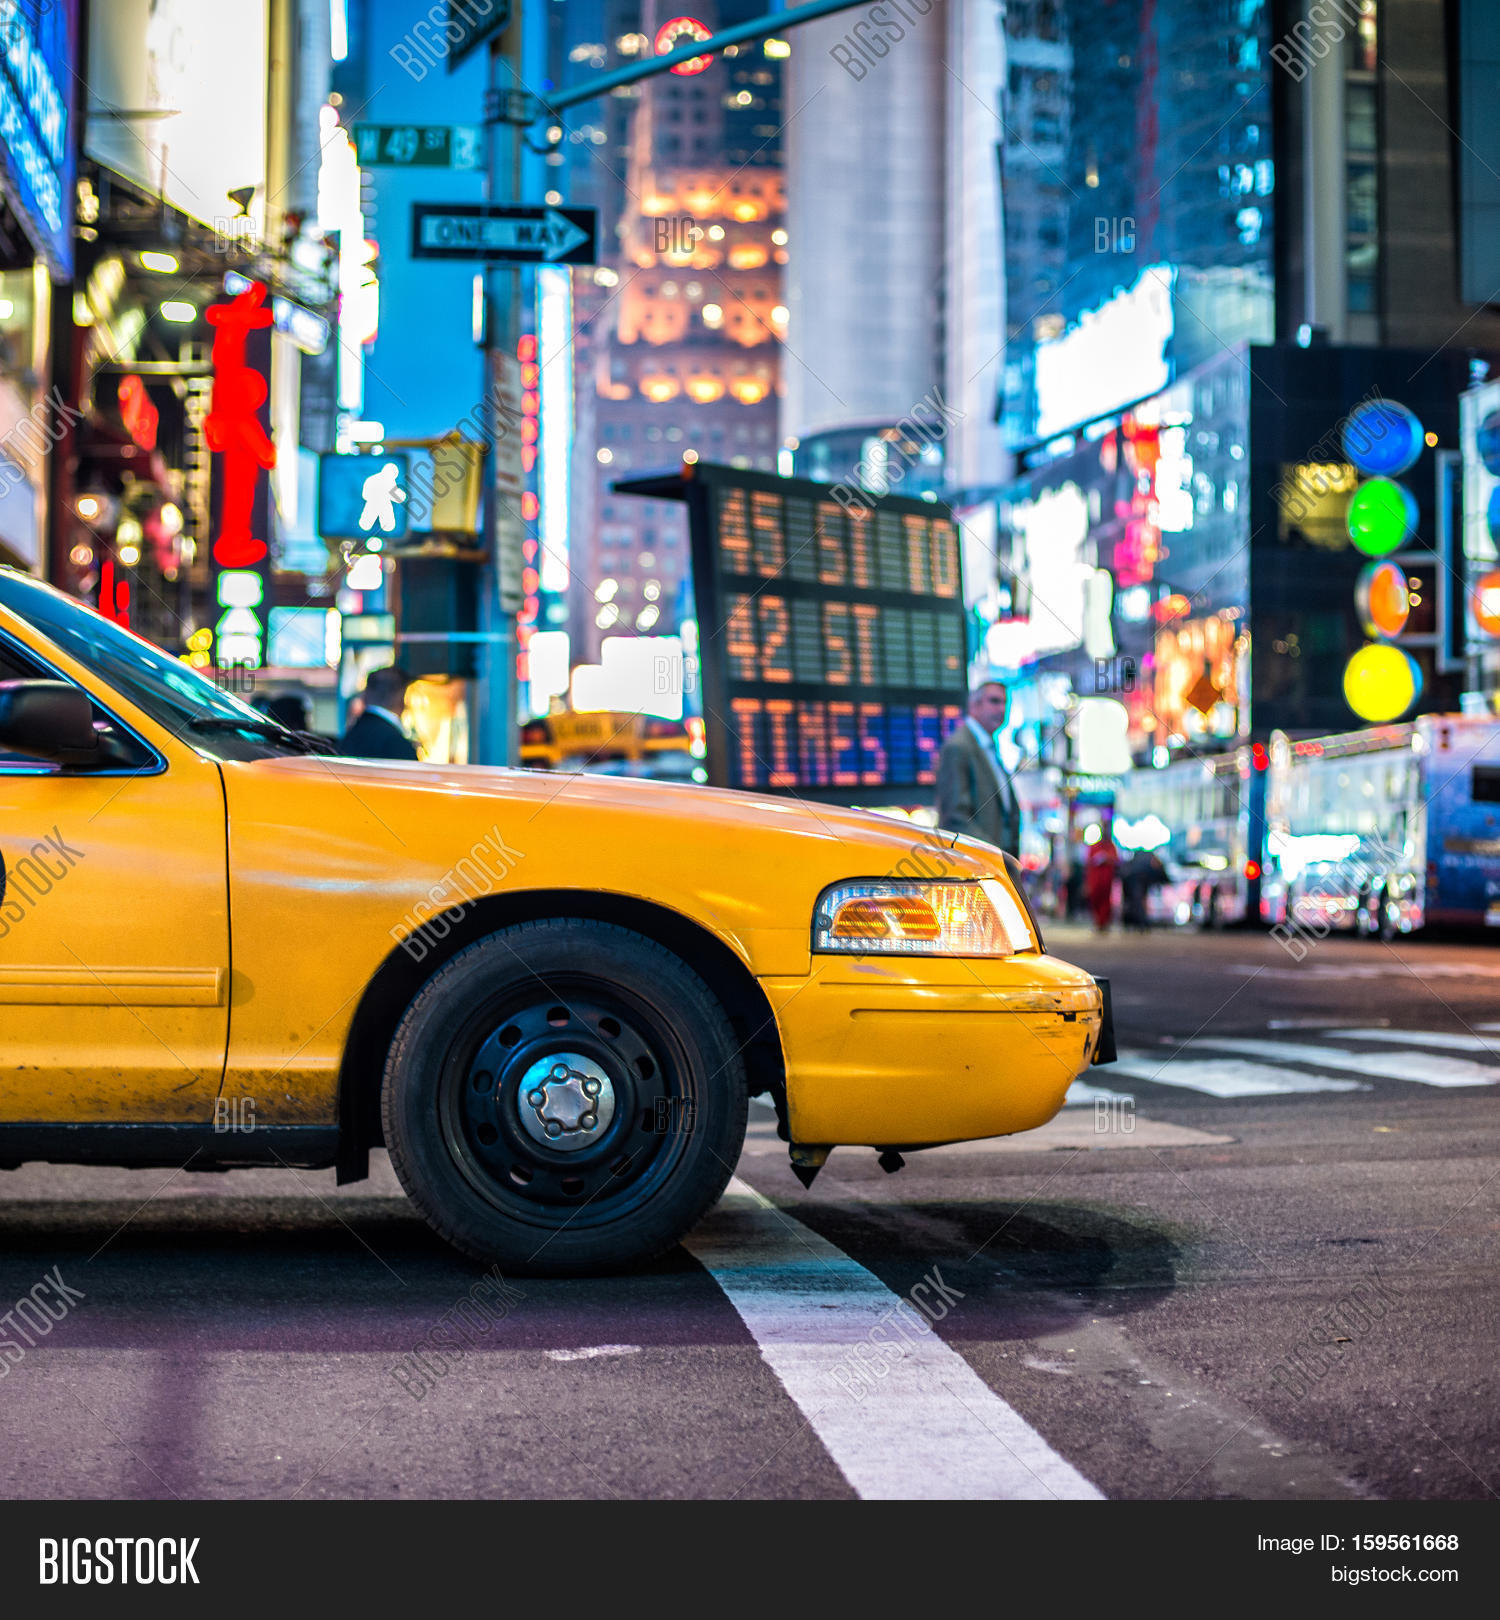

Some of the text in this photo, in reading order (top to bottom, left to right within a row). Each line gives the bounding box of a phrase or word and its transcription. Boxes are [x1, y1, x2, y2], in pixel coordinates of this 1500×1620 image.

[386, 127, 419, 163] 49
[424, 128, 446, 150] ST
[435, 219, 570, 245] ONE WAY
[719, 487, 958, 598] 45 ST TO
[727, 592, 878, 685] 42 ST
[730, 698, 888, 787] TIMES
